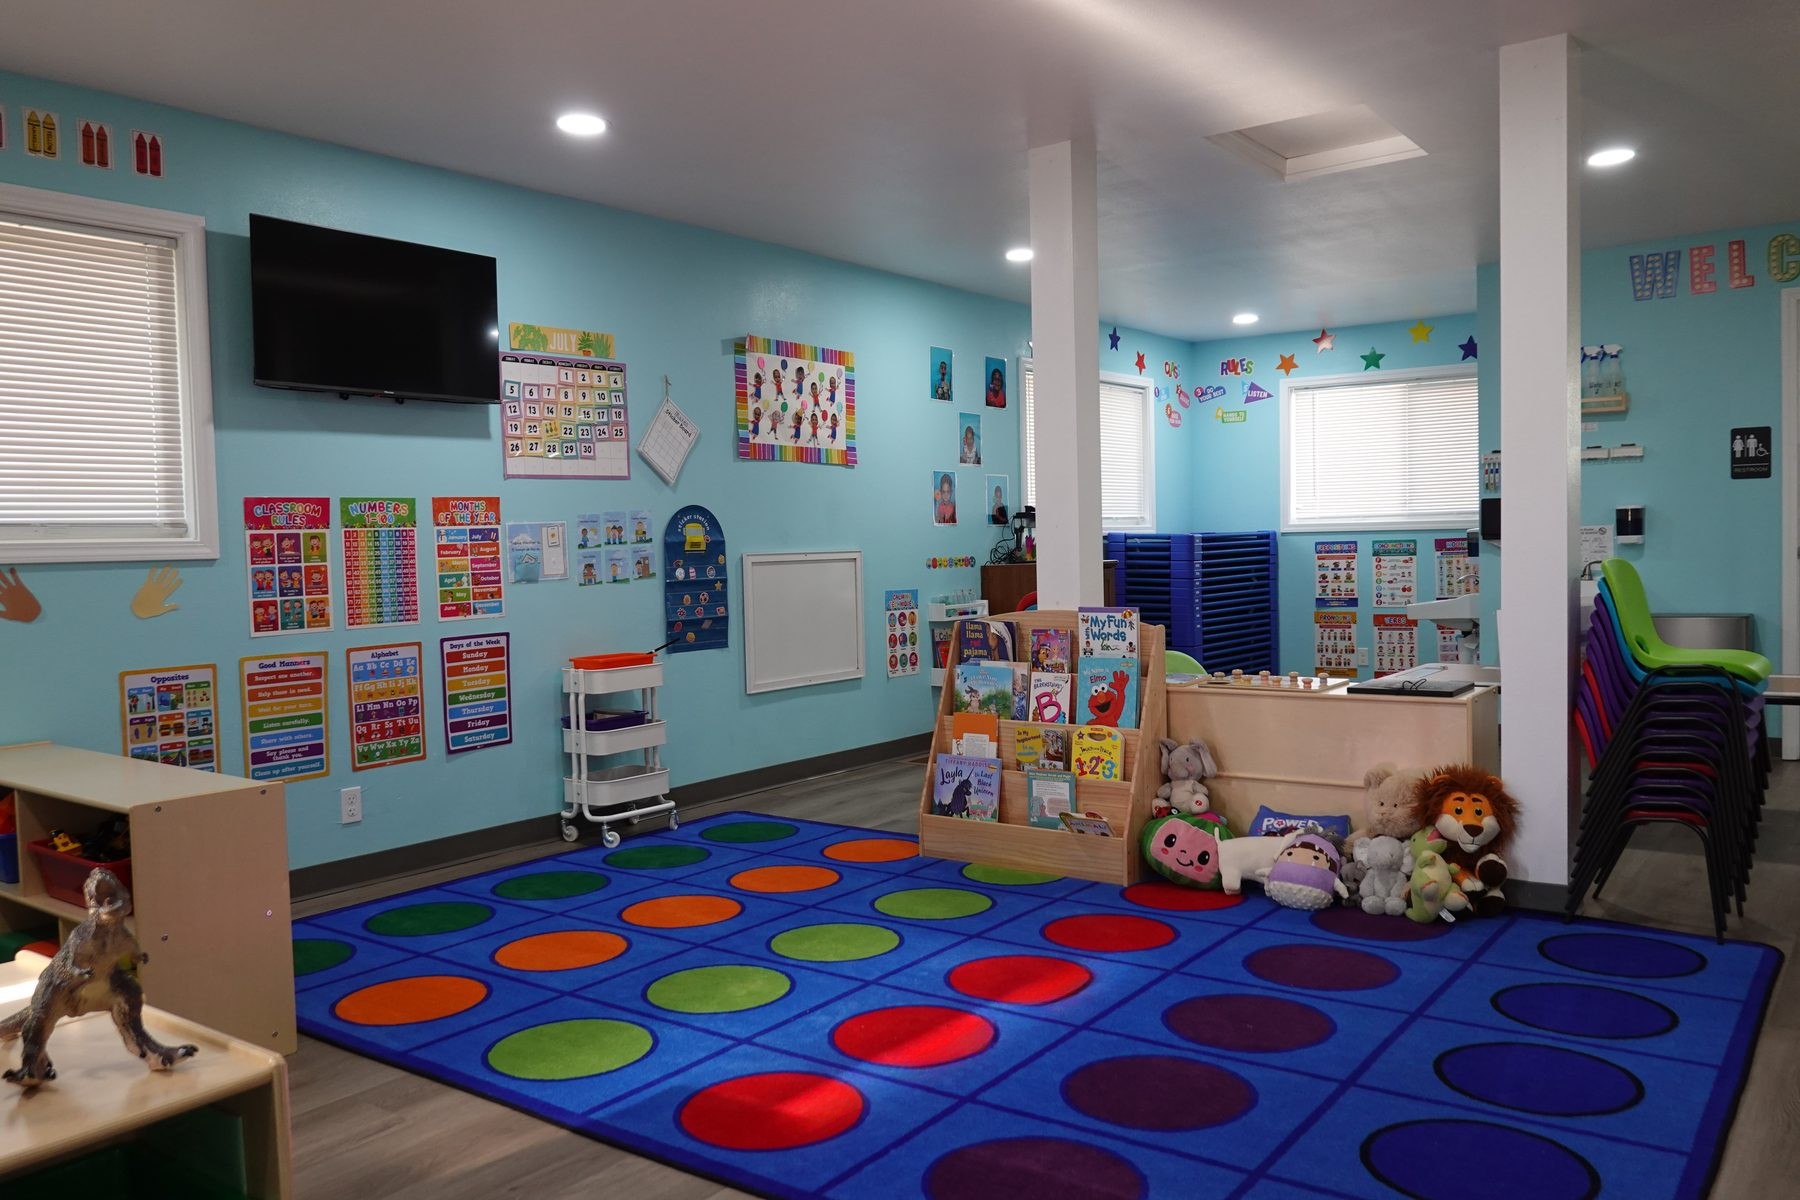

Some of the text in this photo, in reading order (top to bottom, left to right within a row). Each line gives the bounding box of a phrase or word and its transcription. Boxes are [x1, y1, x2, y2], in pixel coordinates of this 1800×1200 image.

[550, 332, 577, 352] JULY
[1221, 358, 1253, 375] RULES
[510, 386, 514, 394] 5
[582, 392, 586, 400] 9
[1247, 390, 1268, 398] LISTEN
[510, 424, 518, 432] 19
[1734, 466, 1768, 474] RESTROOM
[254, 502, 322, 517] CLASSROOM
[348, 501, 409, 516] NUMBERS
[450, 500, 486, 512] MONTHS
[271, 515, 306, 526] RULES
[365, 513, 394, 524] 1-100
[438, 511, 495, 523] OF THE YEAR
[678, 514, 710, 532] sticker station
[966, 622, 982, 630] llama
[1090, 615, 1128, 629] My Fun
[1090, 628, 1127, 642] Words
[371, 650, 399, 659] Alphabet
[462, 651, 488, 659] Sunday
[964, 648, 987, 658] pajama
[353, 664, 364, 672] Aa
[463, 665, 489, 673] Monday
[150, 674, 189, 684] Opposites
[463, 678, 491, 687] Tuesday
[1089, 674, 1107, 684] Elmo
[459, 692, 496, 701] Wednesday
[462, 705, 494, 715] Thursday
[468, 720, 490, 728] Friday
[464, 732, 495, 743] Saturday
[1086, 755, 1102, 776] 2
[1102, 760, 1116, 779] 3
[940, 767, 964, 786] Layla
[980, 769, 993, 779] Last
[977, 778, 992, 788] Black
